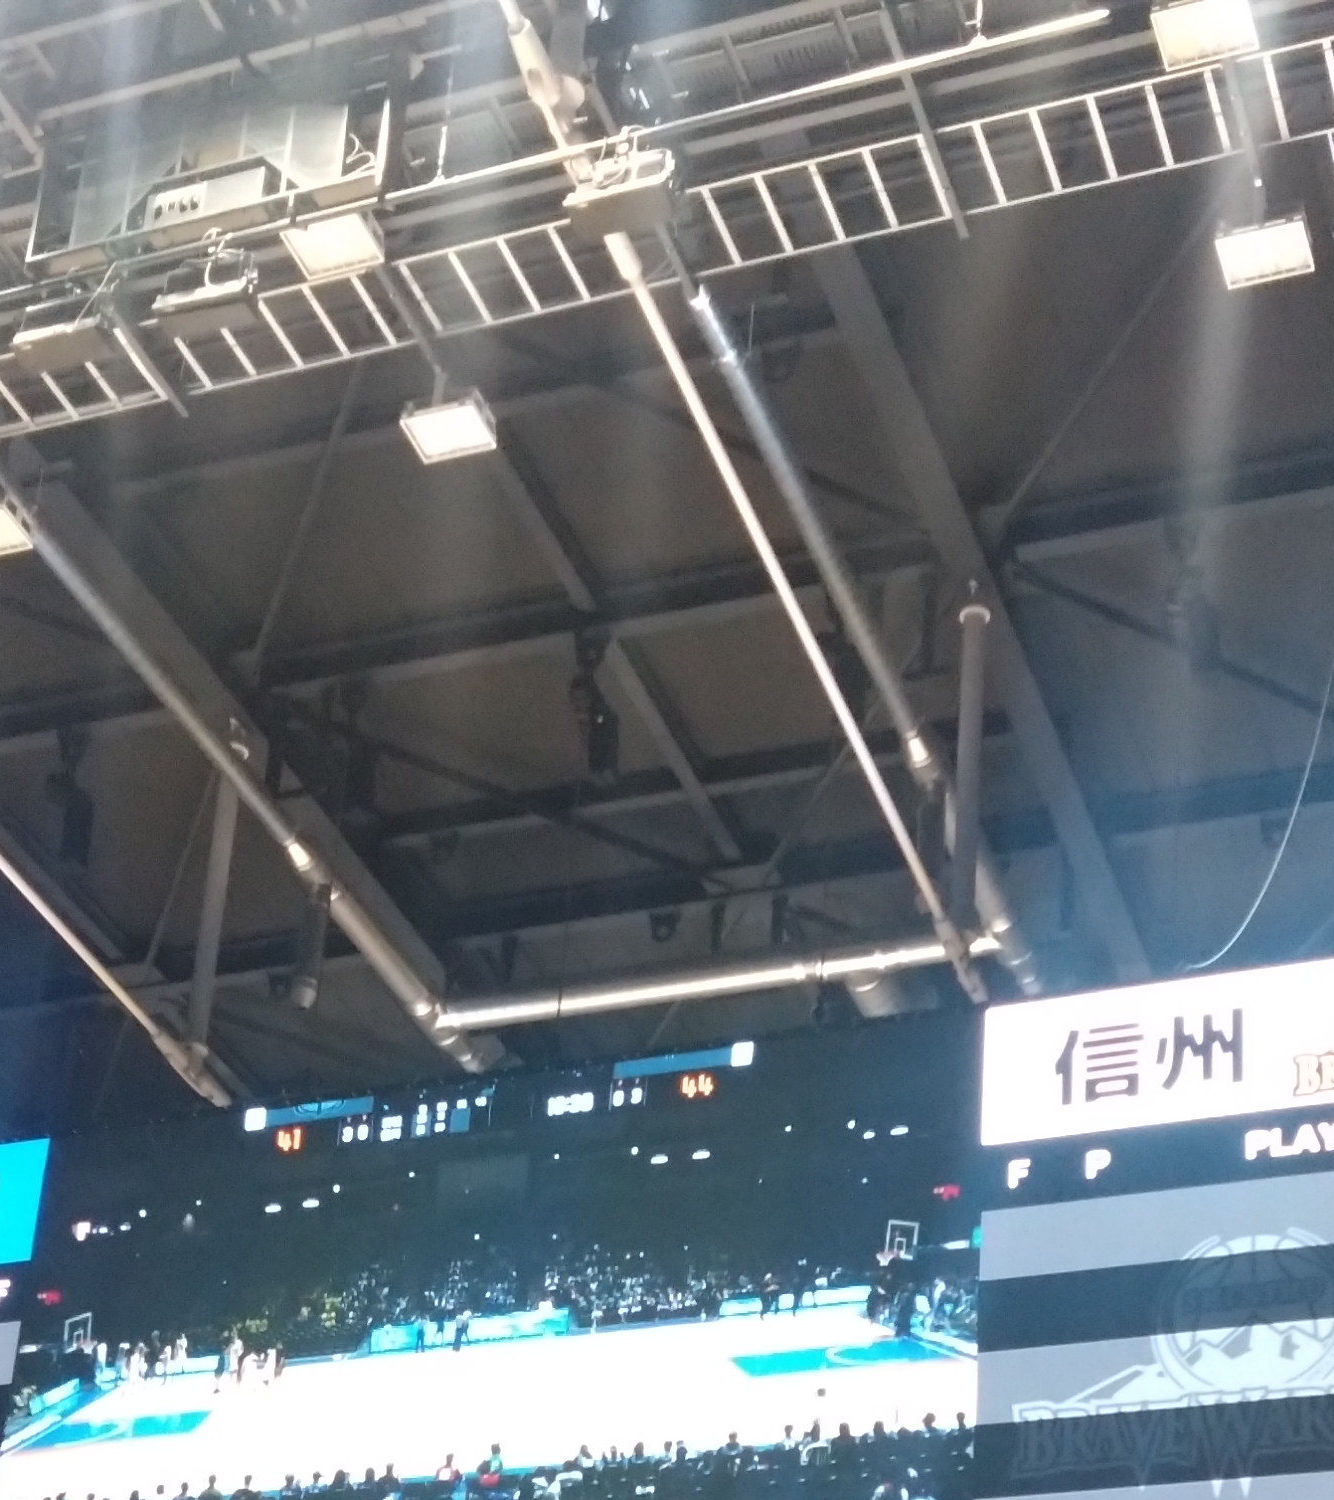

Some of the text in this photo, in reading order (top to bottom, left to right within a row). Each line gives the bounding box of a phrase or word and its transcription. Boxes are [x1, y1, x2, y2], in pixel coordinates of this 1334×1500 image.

[1055, 1008, 1244, 1105] 信州
[1008, 1159, 1031, 1189] F
[1084, 1149, 1112, 1180] P
